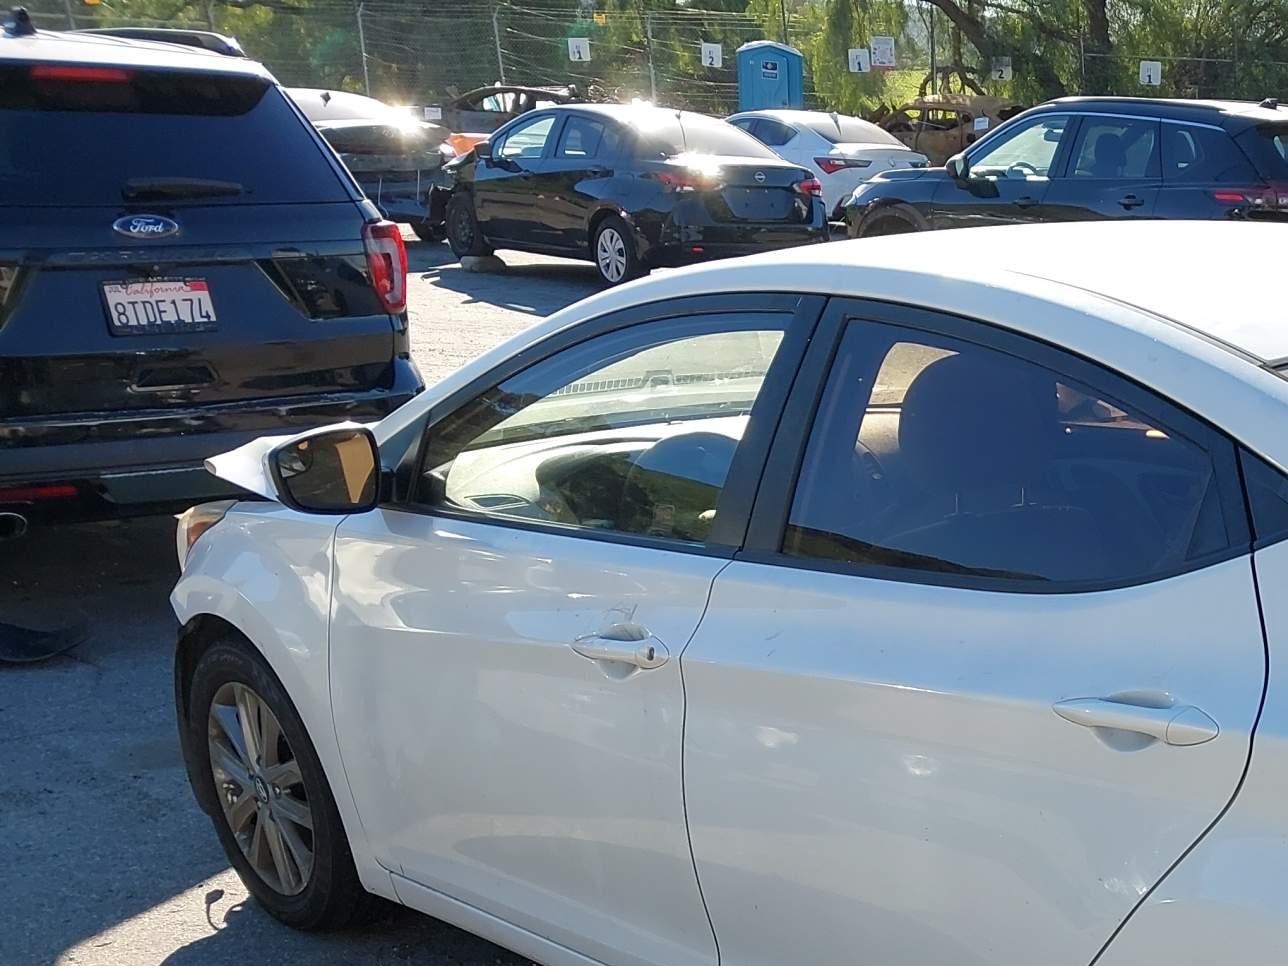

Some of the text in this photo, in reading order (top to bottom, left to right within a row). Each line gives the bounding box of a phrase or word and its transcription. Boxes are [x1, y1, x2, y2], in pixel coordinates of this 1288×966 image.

[998, 69, 1005, 79] 2
[1146, 74, 1153, 84] 1
[129, 217, 164, 233] Ford
[126, 281, 190, 297] California
